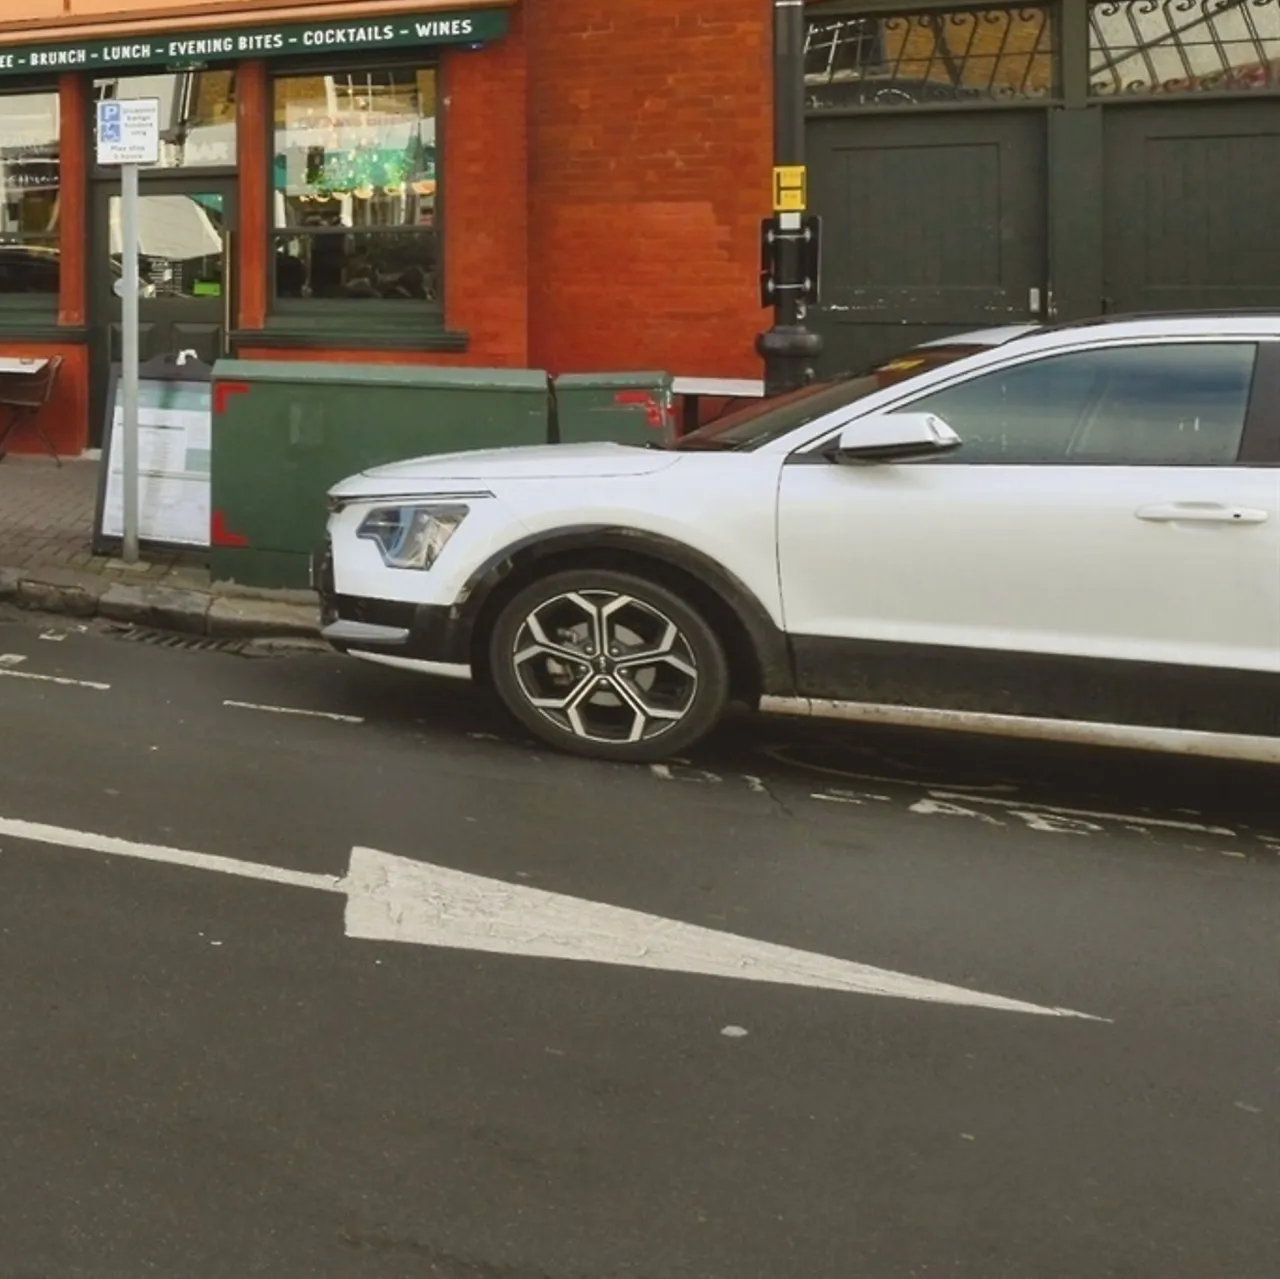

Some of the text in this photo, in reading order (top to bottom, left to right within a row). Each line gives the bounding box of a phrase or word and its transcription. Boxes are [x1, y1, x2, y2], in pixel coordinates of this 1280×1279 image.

[29, 49, 86, 66] BRUNCH
[103, 44, 151, 60] LUNCH
[169, 37, 233, 56] EVENING
[239, 34, 283, 51] BITES
[303, 25, 394, 46] COCKTAILS
[415, 19, 473, 38] WINES
[104, 105, 117, 120] P
